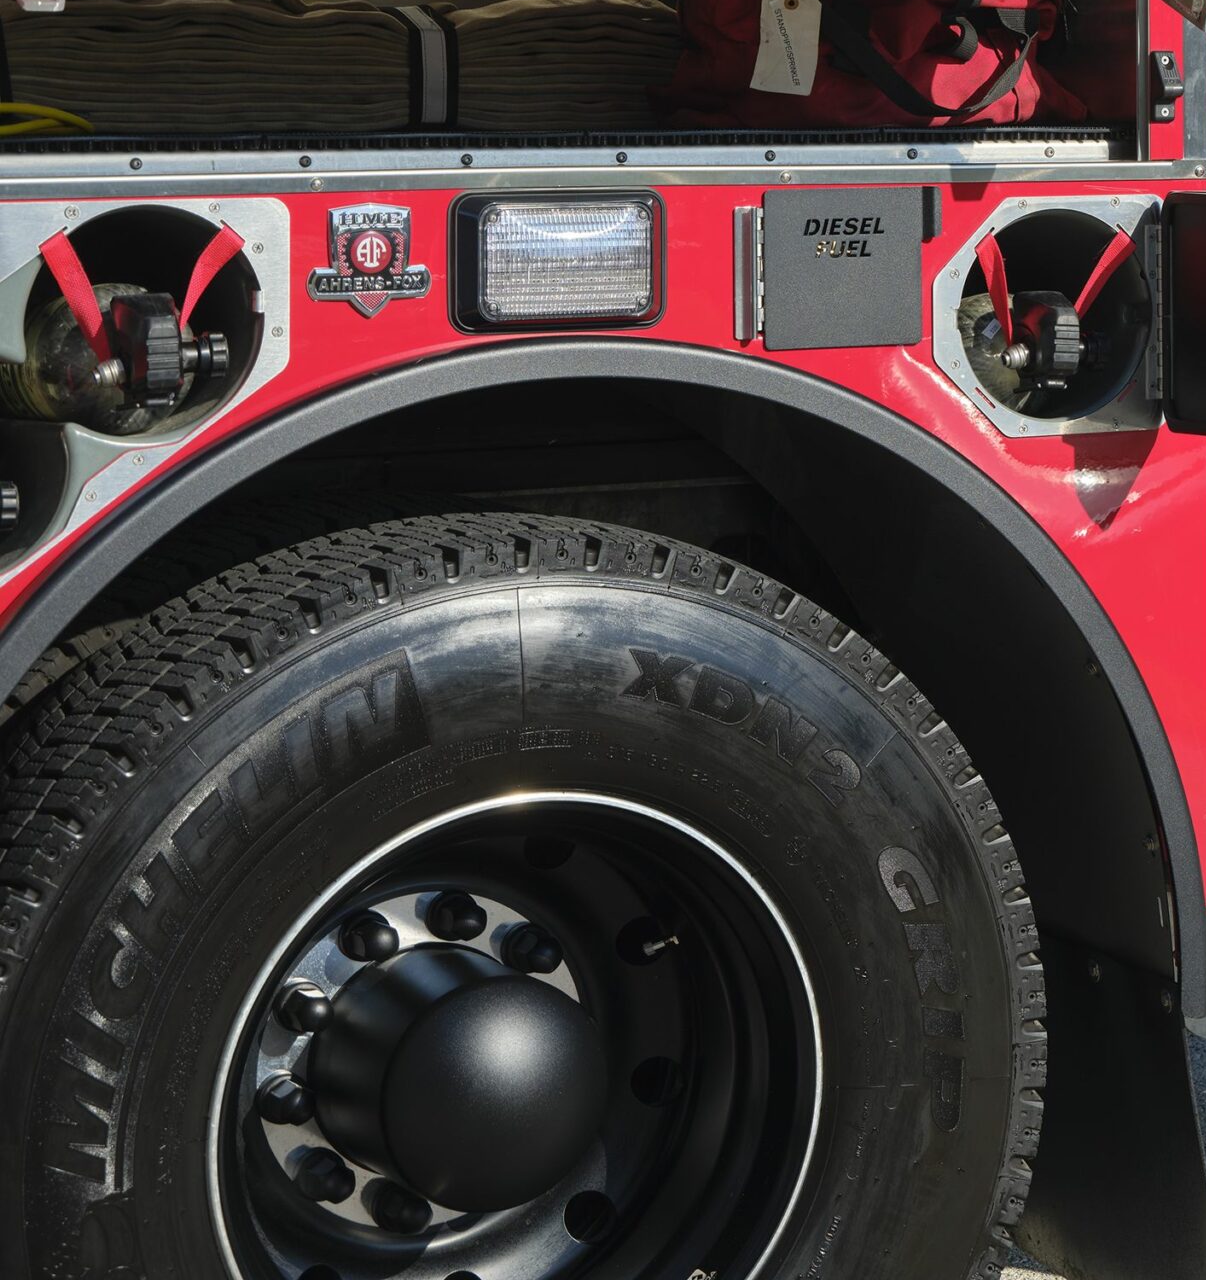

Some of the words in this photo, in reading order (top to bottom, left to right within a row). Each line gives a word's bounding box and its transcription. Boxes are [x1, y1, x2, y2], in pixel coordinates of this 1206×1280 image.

[338, 211, 404, 226] HME
[803, 217, 885, 237] DIESEL
[815, 240, 872, 259] FUEL
[318, 274, 422, 292] AHRENS-FOX
[43, 662, 404, 1187] MICHELIN
[875, 844, 966, 1134] GRIP
